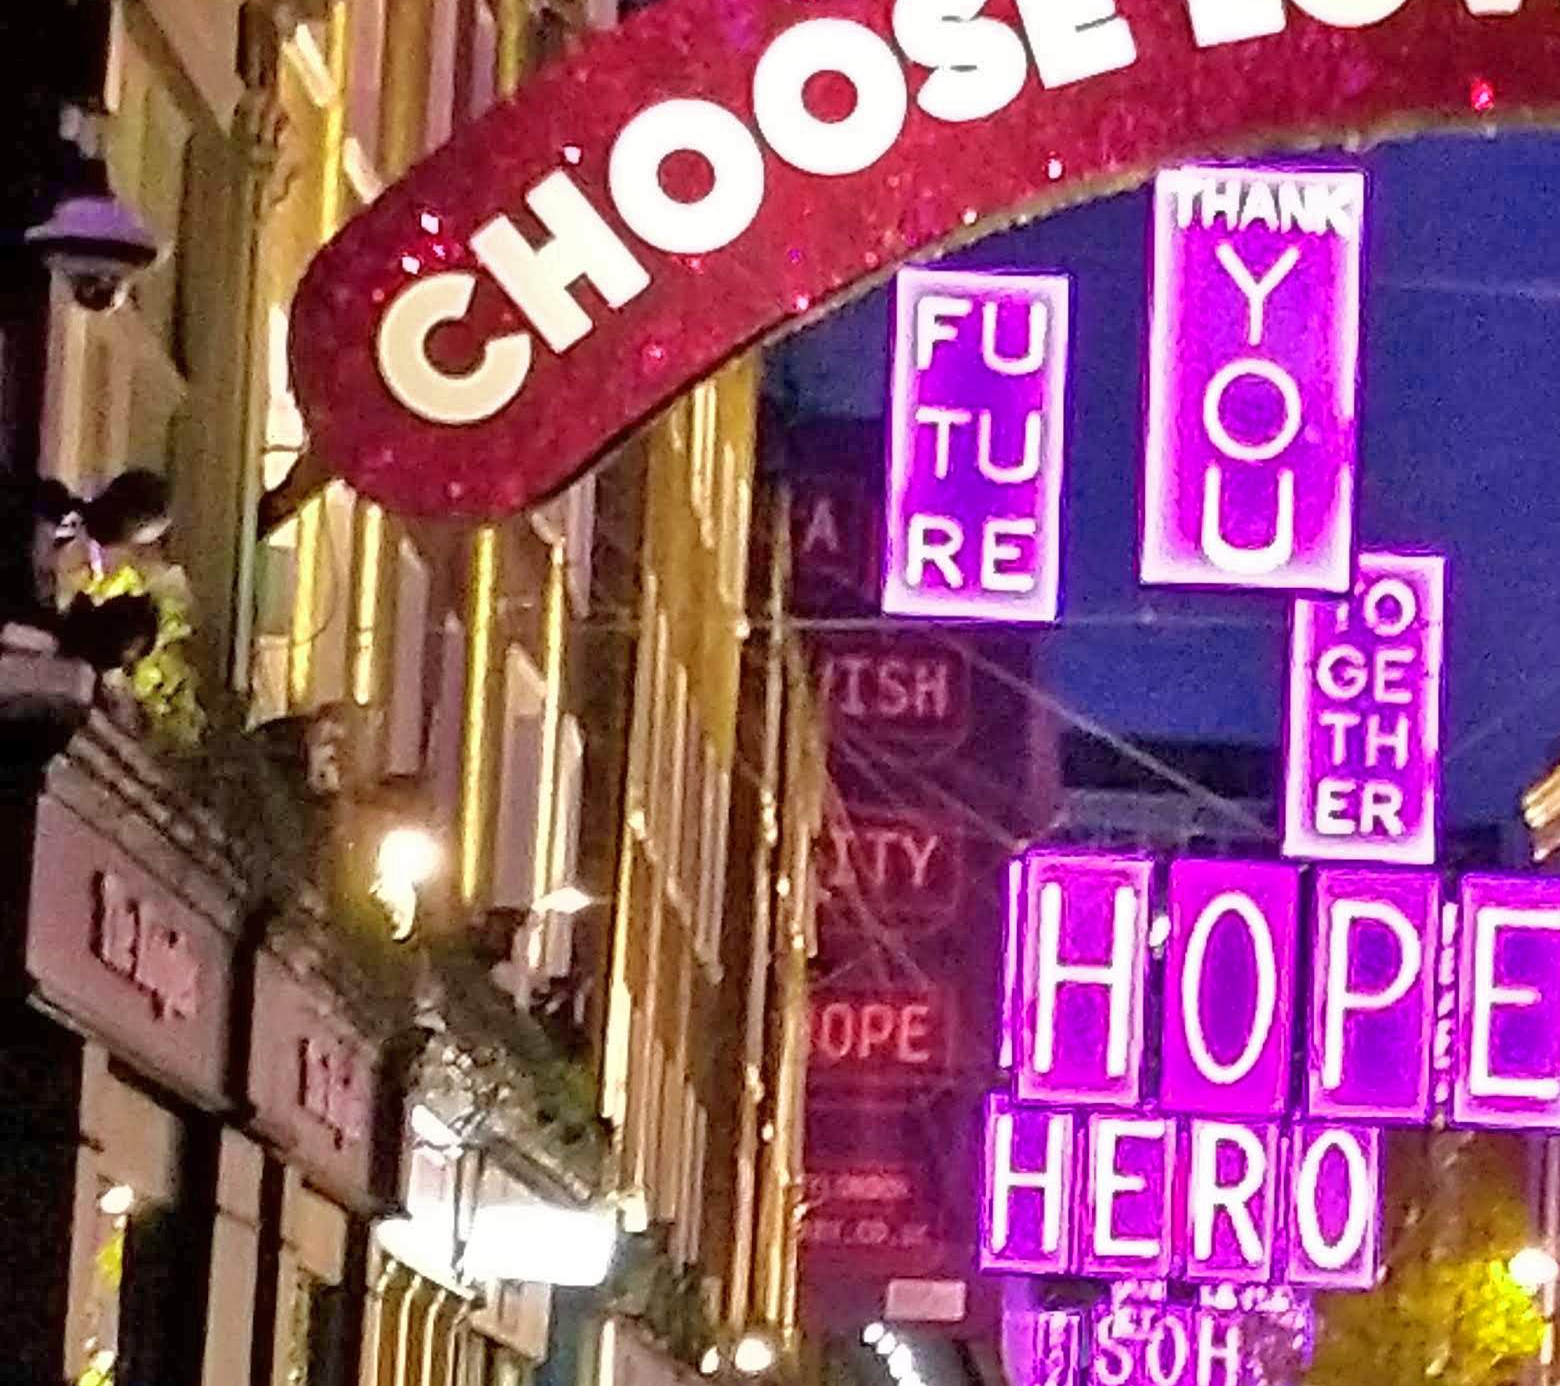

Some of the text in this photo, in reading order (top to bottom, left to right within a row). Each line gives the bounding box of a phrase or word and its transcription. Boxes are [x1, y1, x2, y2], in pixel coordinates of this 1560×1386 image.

[1170, 179, 1352, 237] THANK
[1200, 243, 1303, 577] YOU
[825, 657, 948, 716] ISH
[829, 834, 938, 887] ITY
[818, 1001, 932, 1063] OPE
[990, 1113, 1370, 1270] HERO
